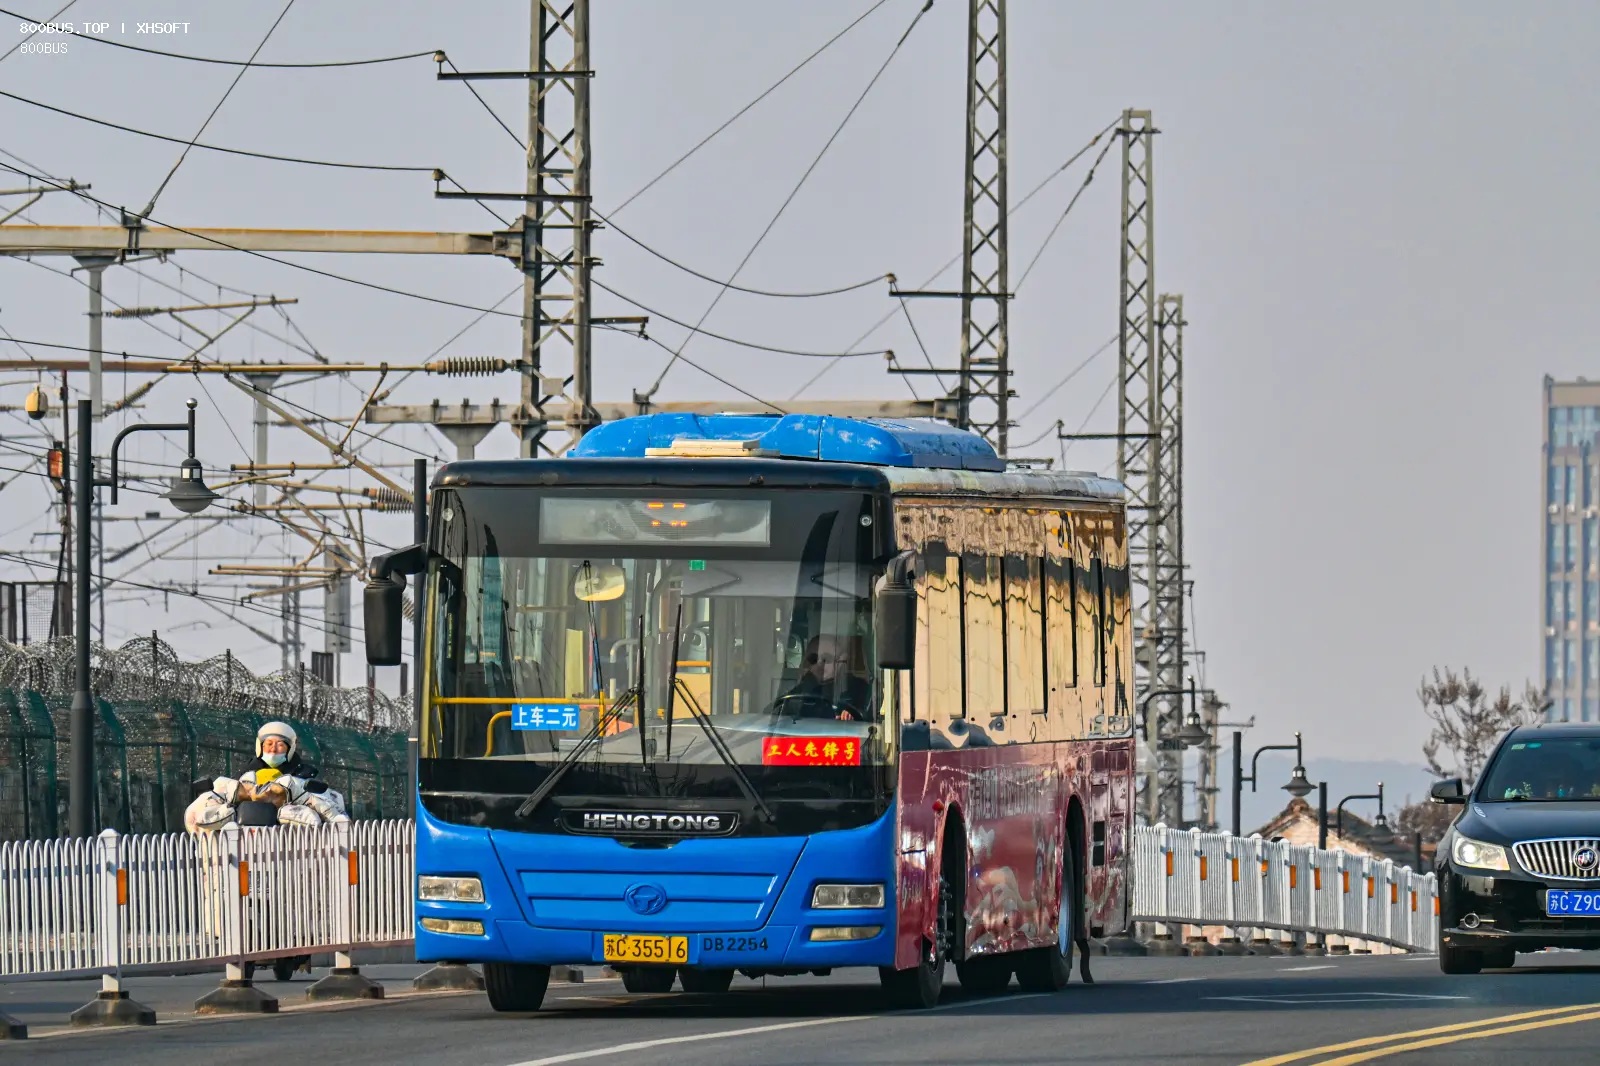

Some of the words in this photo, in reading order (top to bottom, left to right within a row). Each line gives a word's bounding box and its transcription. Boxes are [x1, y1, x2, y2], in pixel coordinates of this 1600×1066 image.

[513, 705, 577, 728] 上车二元
[767, 740, 856, 761] 工人先锋号
[583, 812, 721, 831] HENGTONG
[703, 937, 769, 951] DB2254
